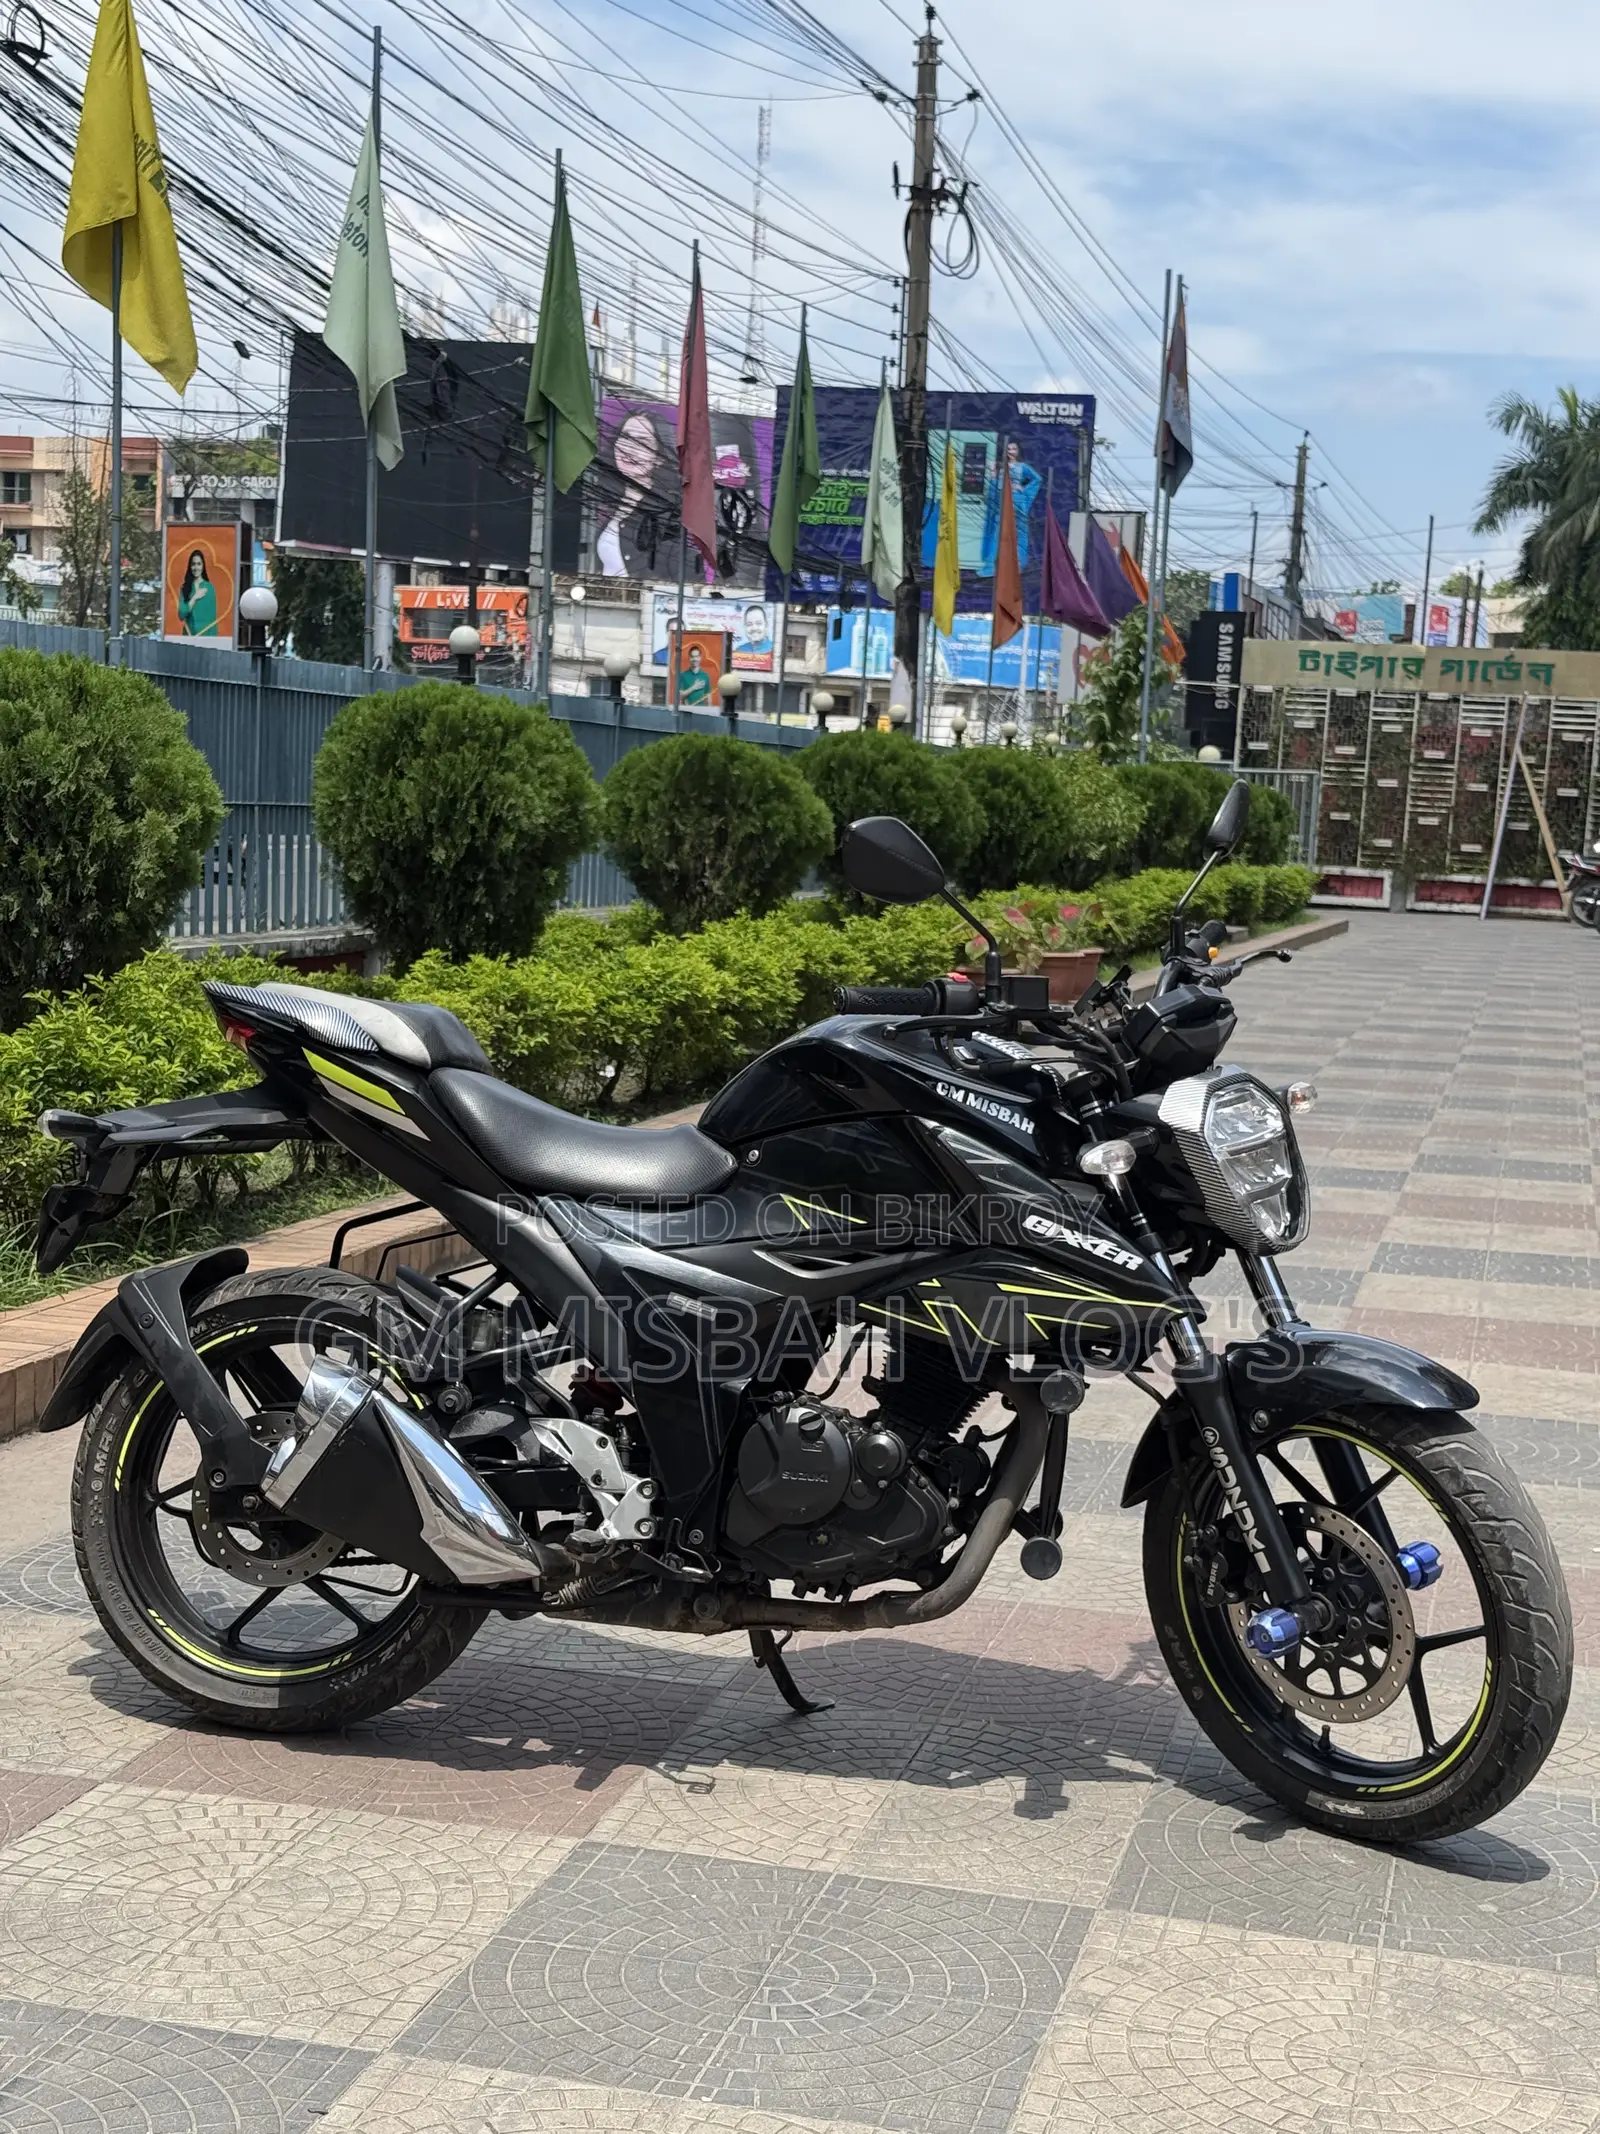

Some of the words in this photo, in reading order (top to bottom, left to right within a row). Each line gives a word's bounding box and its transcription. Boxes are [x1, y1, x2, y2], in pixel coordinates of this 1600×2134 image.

[1017, 402, 1084, 416] WALTON
[1214, 622, 1234, 710] SAMSUNG
[1299, 649, 1425, 680] টাইগার
[1440, 653, 1555, 686] গার্ডেন
[966, 1092, 1036, 1135] MISBAH
[1022, 1215, 1144, 1271] GIXXER
[782, 1471, 828, 1483] SUZUKI
[1209, 1447, 1271, 1574] SUZUKI
[1207, 1561, 1219, 1597] BYBRE
